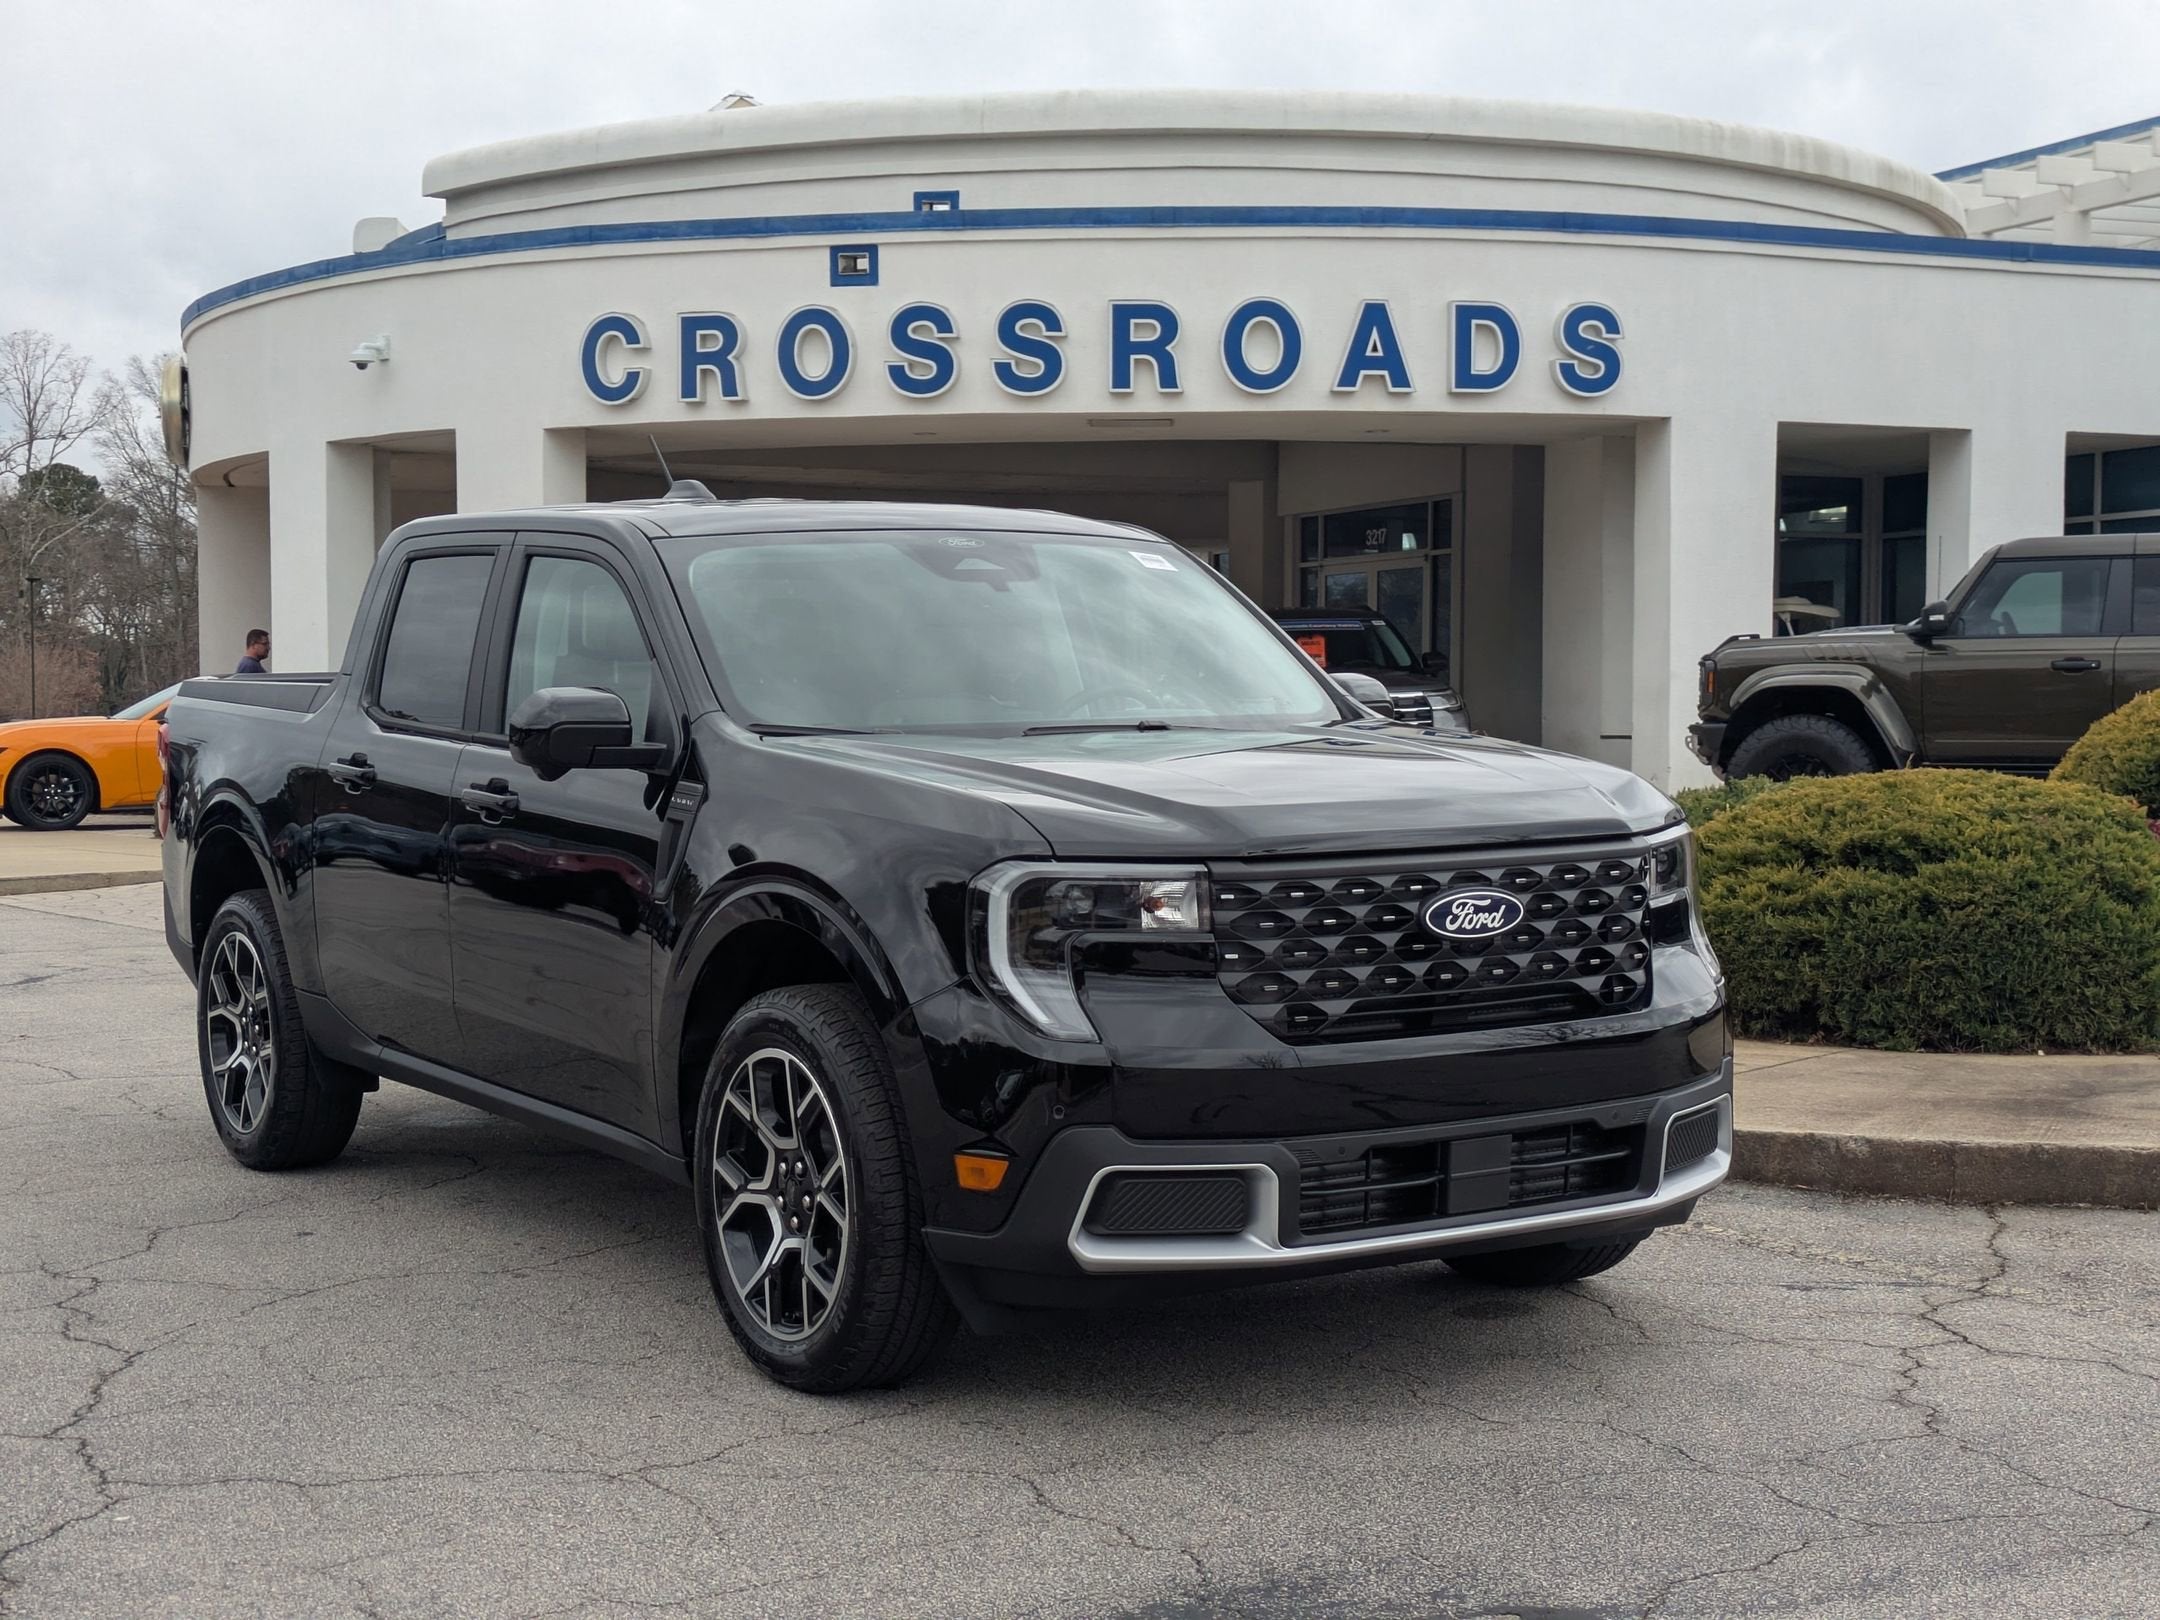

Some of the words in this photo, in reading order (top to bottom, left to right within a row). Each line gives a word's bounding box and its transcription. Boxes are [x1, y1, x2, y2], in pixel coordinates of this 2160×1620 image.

[579, 297, 1625, 405] CROSSROADS
[1366, 528, 1387, 545] 3217
[1445, 899, 1506, 931] Ford
